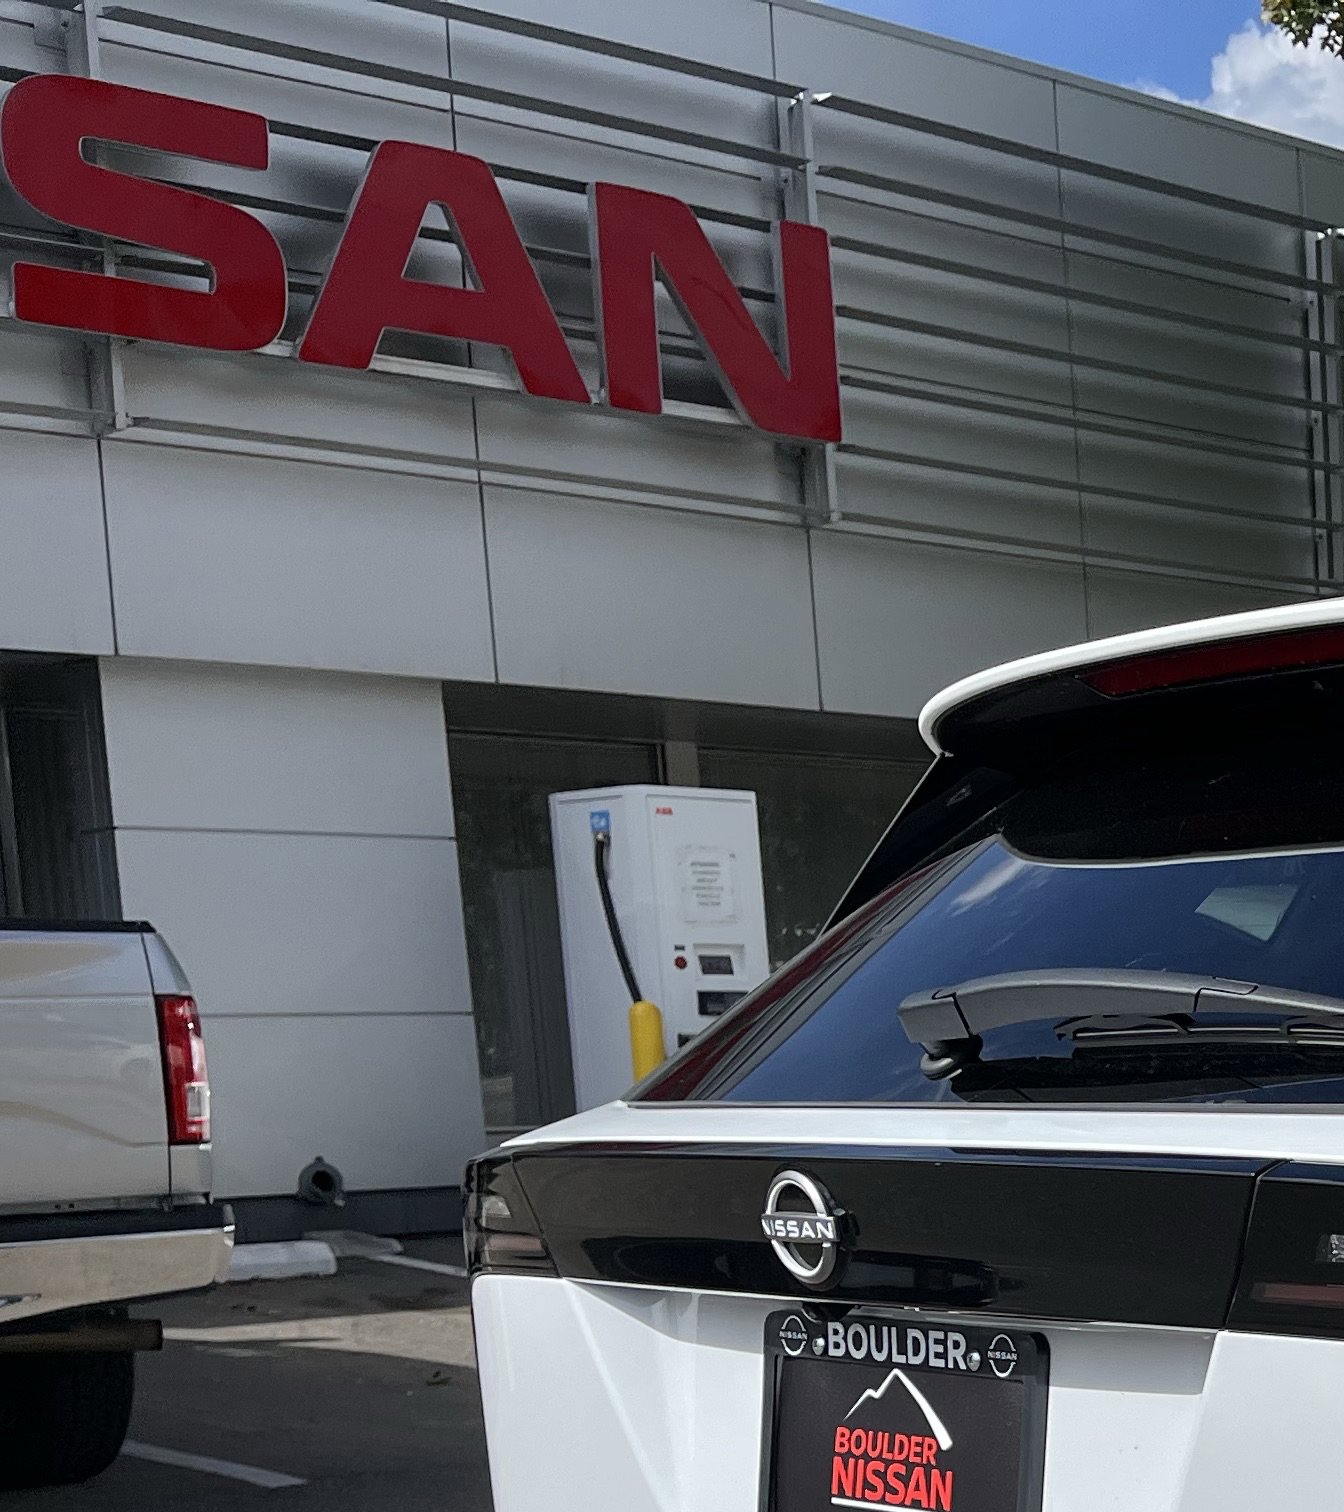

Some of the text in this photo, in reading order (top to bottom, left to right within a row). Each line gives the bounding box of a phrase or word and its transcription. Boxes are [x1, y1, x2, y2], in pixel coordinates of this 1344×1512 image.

[1, 74, 842, 443] SAN
[761, 1217, 835, 1241] NISSAN
[827, 1321, 967, 1370] BOULDER
[987, 1350, 1018, 1361] NISSAN
[834, 1426, 937, 1466] BOULDER
[831, 1456, 953, 1512] NISSAN
